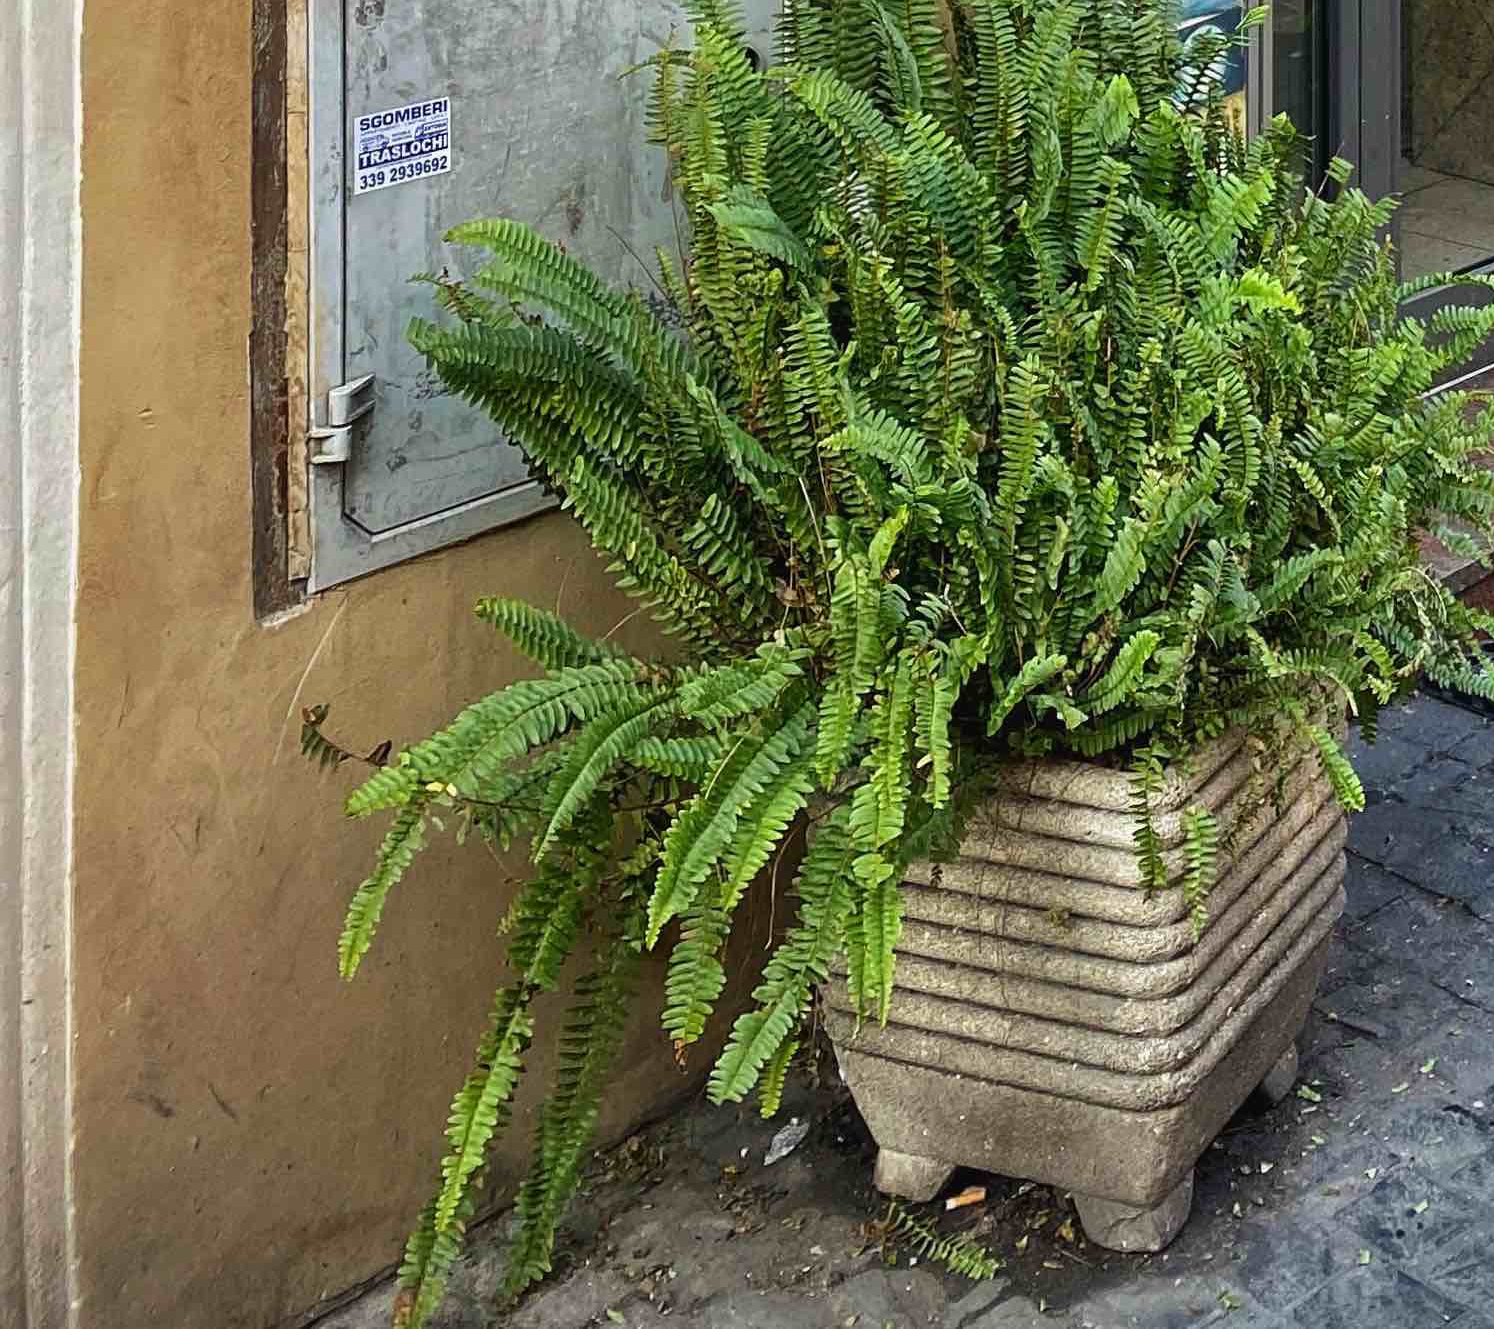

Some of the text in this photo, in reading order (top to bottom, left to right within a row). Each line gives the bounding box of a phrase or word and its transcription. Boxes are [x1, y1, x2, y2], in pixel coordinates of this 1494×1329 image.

[359, 99, 449, 132] SGOMBERI
[359, 133, 449, 170] TRASLOCHI
[359, 154, 449, 191] 339 2939692
